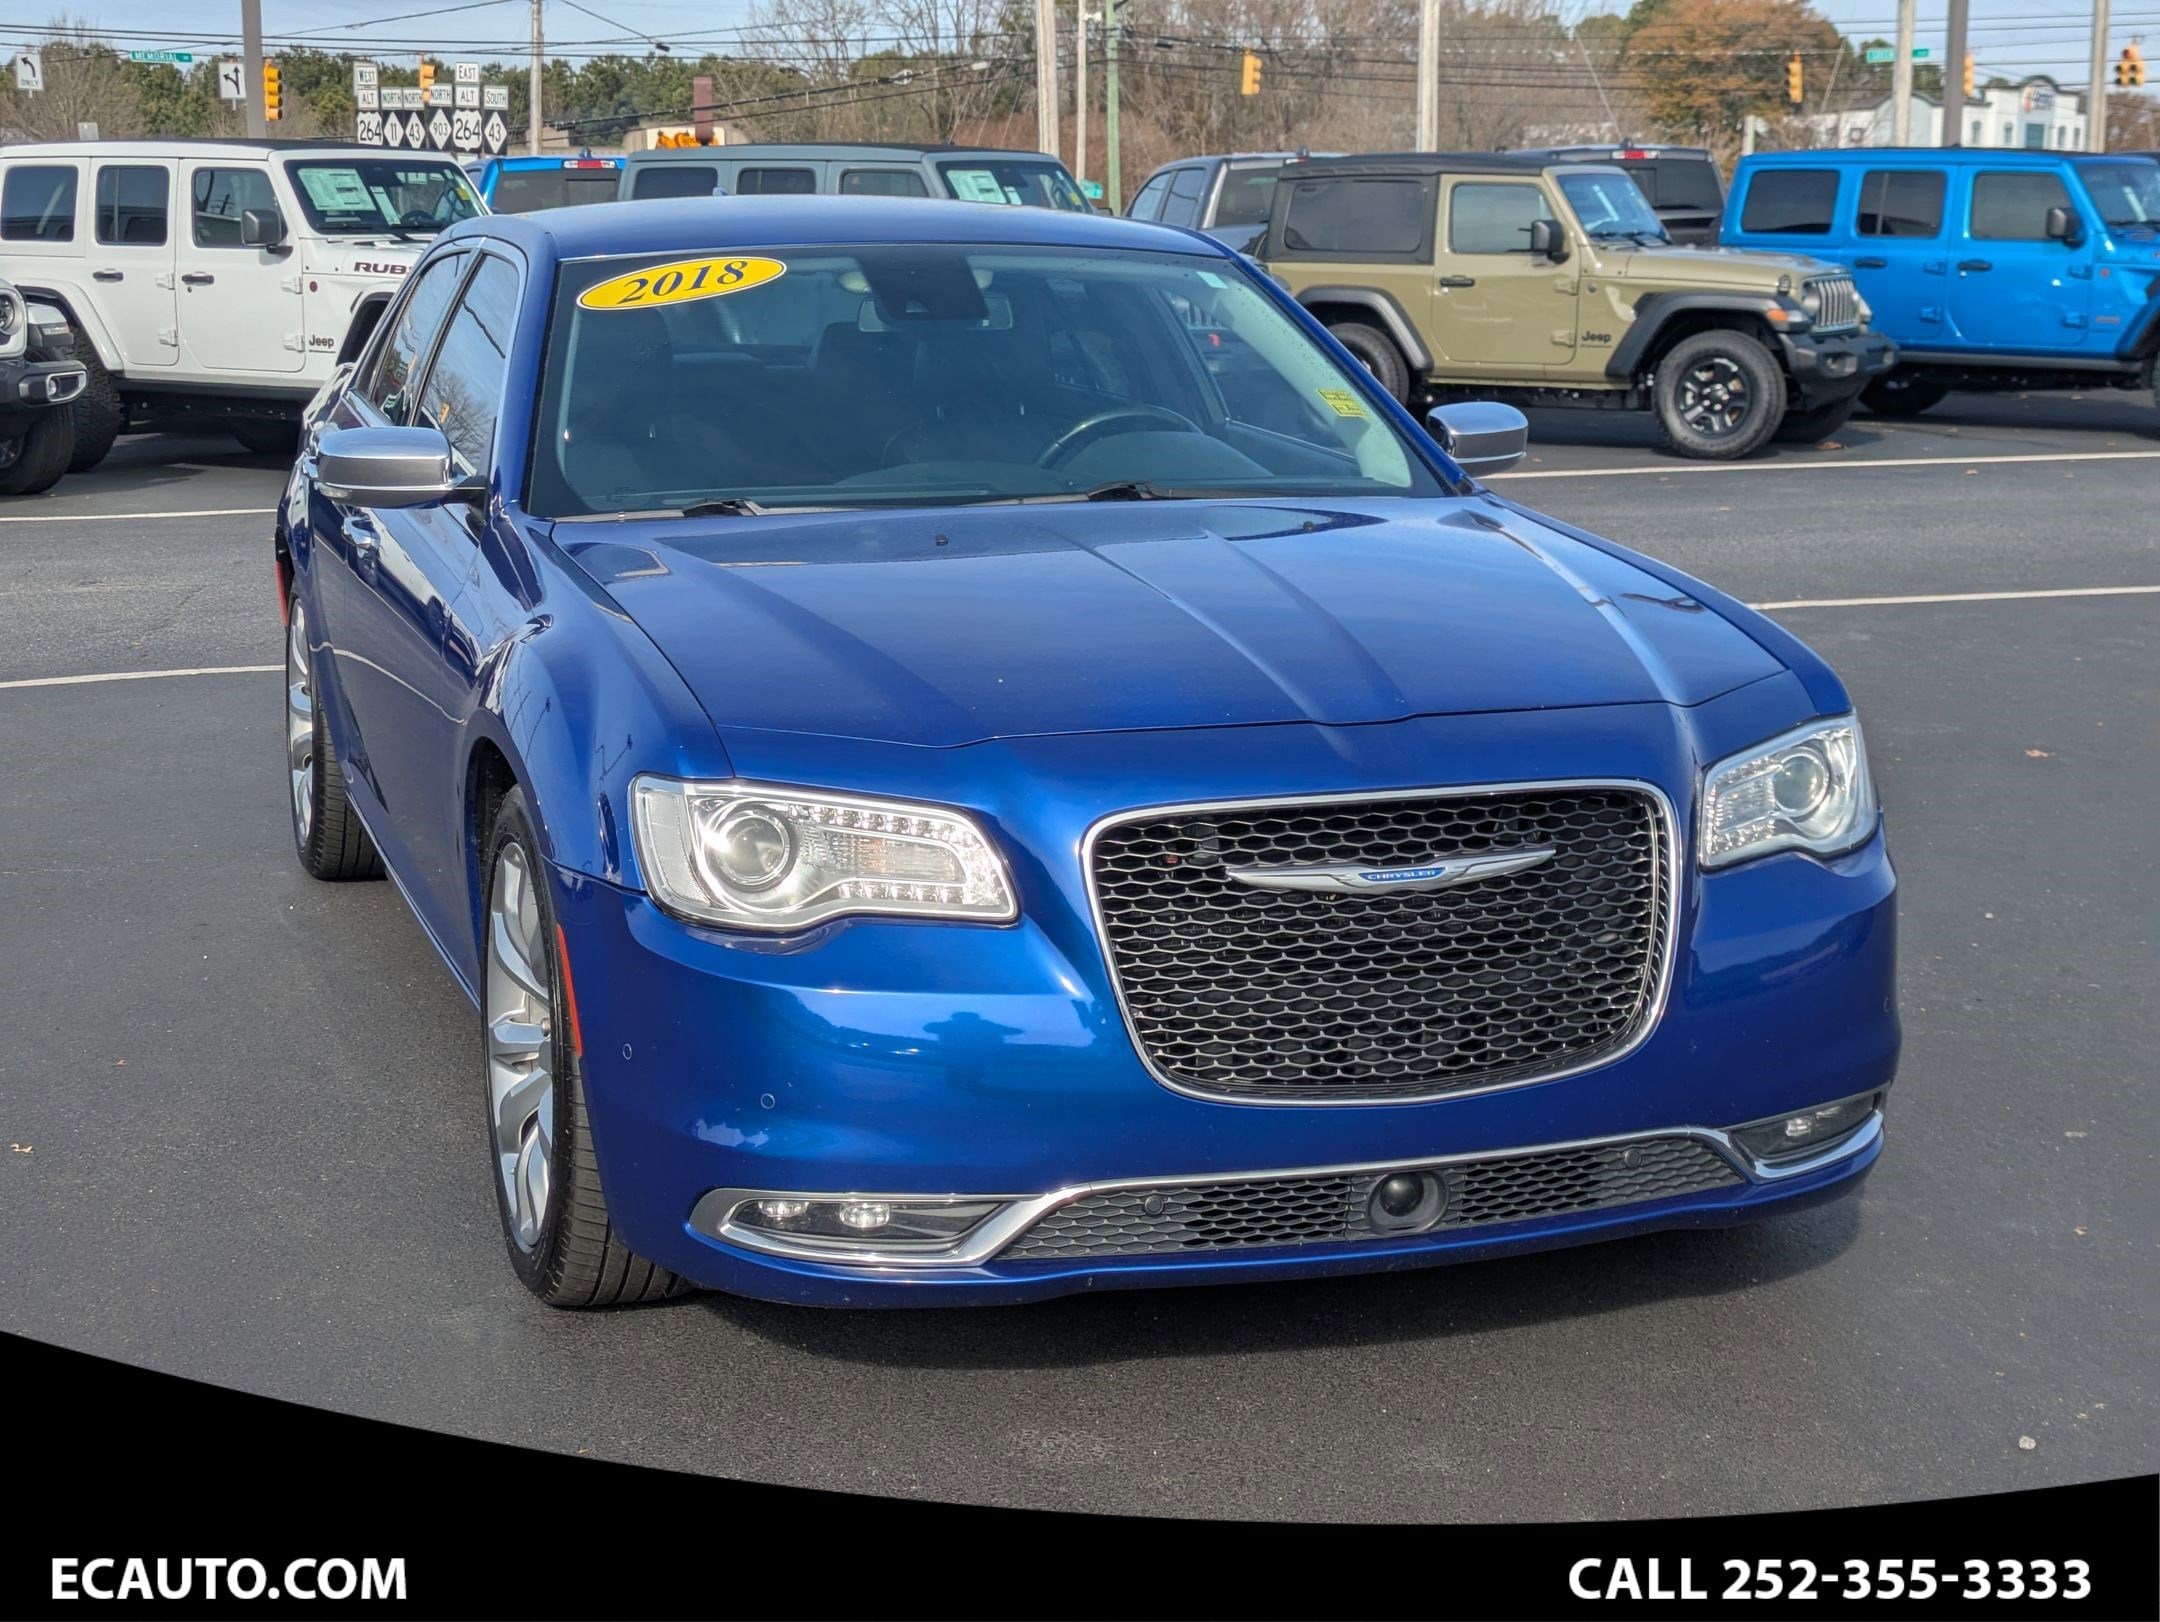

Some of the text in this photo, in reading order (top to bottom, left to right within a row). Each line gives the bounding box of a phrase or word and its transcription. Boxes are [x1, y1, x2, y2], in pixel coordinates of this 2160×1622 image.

[359, 69, 375, 82] WEST
[458, 66, 476, 80] EAST
[362, 92, 374, 104] ALT
[382, 92, 401, 104] NORTH
[430, 88, 450, 101] NORTH
[460, 89, 475, 102] ALT
[485, 91, 507, 104] SOUTH
[359, 119, 382, 142] 264
[390, 121, 398, 139] 11
[408, 121, 420, 138] 43
[432, 120, 448, 136] 903
[455, 118, 481, 141] 264
[488, 123, 501, 141] 43
[354, 262, 412, 274] RUB
[616, 260, 748, 304] 2018
[308, 334, 334, 349] Jeep
[1582, 331, 1612, 344] Jeep
[1367, 869, 1436, 880] CHRYSLER
